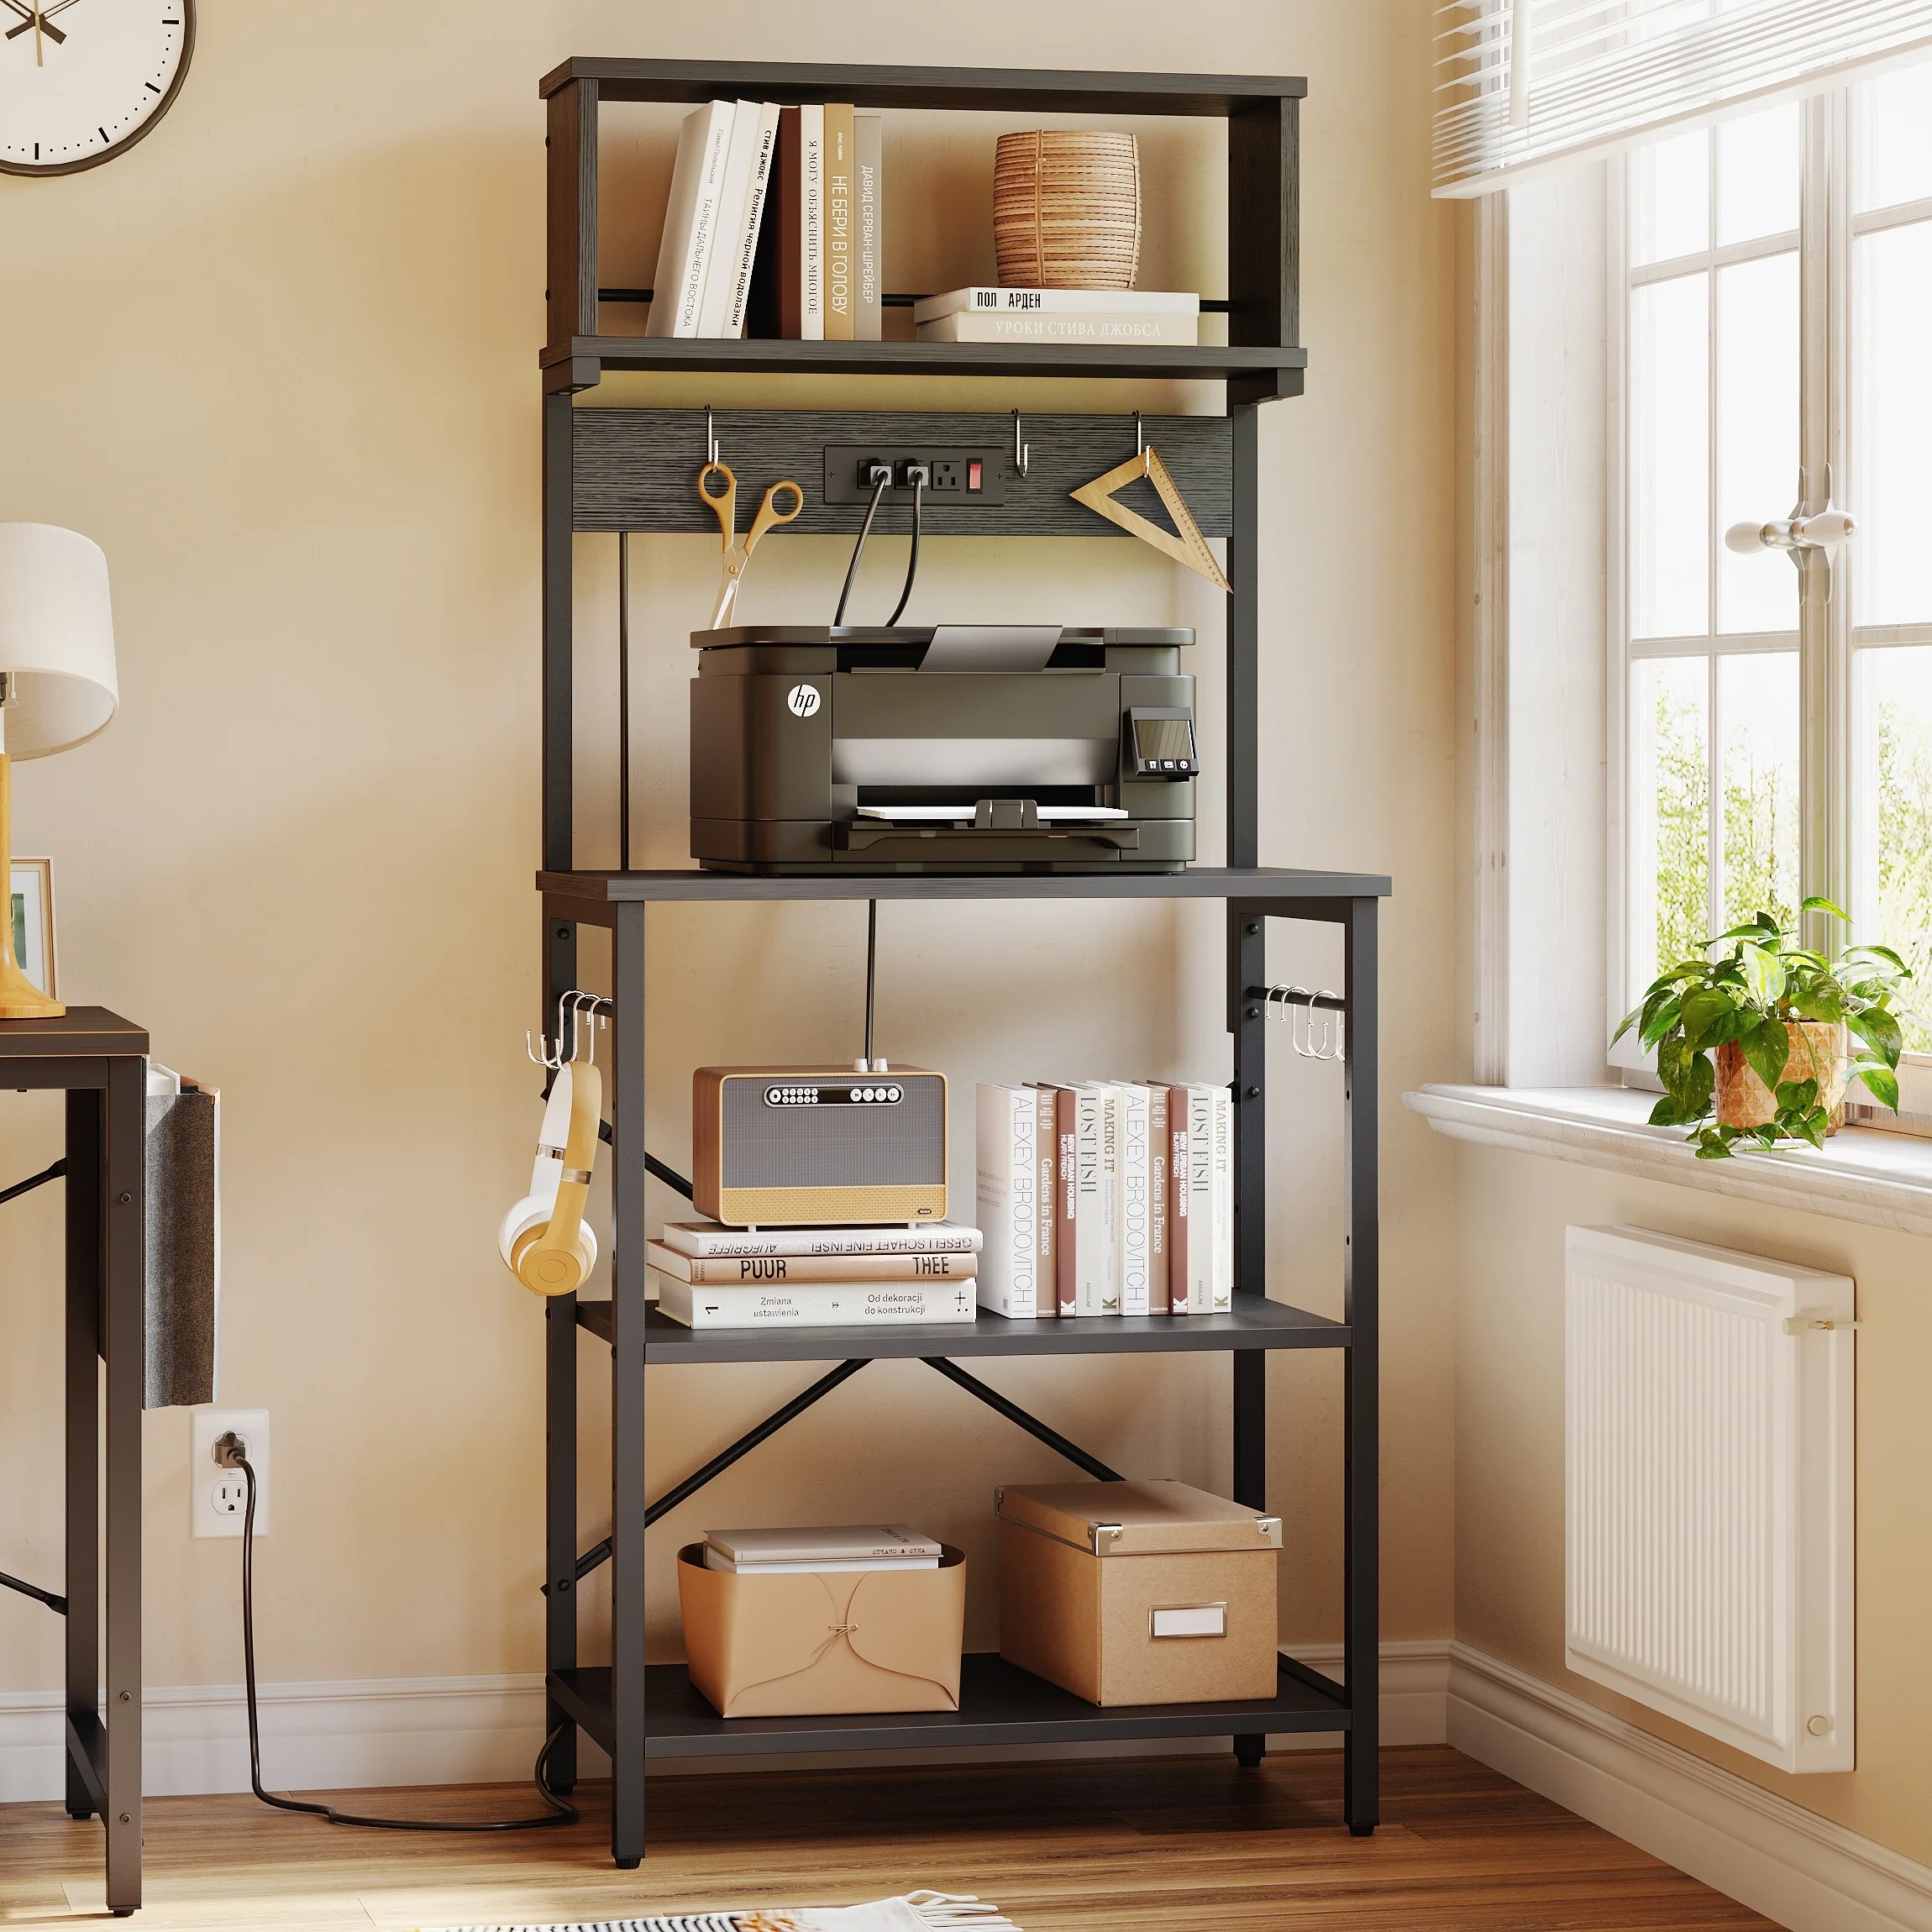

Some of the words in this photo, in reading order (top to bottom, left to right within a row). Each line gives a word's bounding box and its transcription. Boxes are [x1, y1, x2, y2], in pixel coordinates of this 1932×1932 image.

[808, 151, 817, 184] МОГУ
[832, 176, 848, 195] НЕ
[861, 165, 874, 203] ДАВИД
[748, 187, 764, 230] Религия
[808, 188, 817, 260] ОБЪЯСНИТЬ
[832, 198, 848, 237] БЕРИ
[690, 231, 707, 281] ДАЛЬНЕГО
[741, 232, 754, 270] черной
[832, 241, 848, 252] В
[862, 205, 876, 303] СЕРВАН-ШРЕЙБЕР
[731, 270, 748, 327] водолазки
[808, 265, 817, 315] МНОГОЕ
[832, 255, 848, 316] ГОЛОВУ
[976, 291, 997, 307] ПОЛ
[1008, 292, 1042, 310] АРДЕН
[683, 283, 698, 328] ВОСТОКА
[995, 321, 1044, 335] УРОКИ
[1047, 322, 1096, 336] СТИВА
[1100, 323, 1162, 338] ДЖОБСА
[792, 685, 816, 717] hp
[1013, 1096, 1032, 1171] ALEXEY
[1080, 1097, 1097, 1145] LOST
[1104, 1098, 1116, 1154] MAKING
[1126, 1095, 1145, 1169] ALEXEY
[1192, 1097, 1209, 1145] LOST
[1215, 1099, 1226, 1155] MAKING
[1067, 1134, 1075, 1153] NEW
[1041, 1158, 1053, 1203] Gardens
[1067, 1153, 1075, 1182] URBAN
[1080, 1152, 1097, 1193] FISH
[1104, 1158, 1116, 1173] IT
[1153, 1156, 1165, 1201] Gardens
[1192, 1152, 1209, 1192] FISH
[1215, 1158, 1226, 1173] IT
[1041, 1205, 1053, 1216] in
[1067, 1182, 1075, 1220] HOUSING
[1153, 1203, 1165, 1214] in
[1179, 1180, 1188, 1216] HOUSING
[1013, 1178, 1033, 1303] BRODOVITCH
[1041, 1218, 1053, 1256] France
[1126, 1176, 1146, 1300] BRODOVITCH
[1153, 1215, 1165, 1253] France
[740, 1259, 786, 1279] PUUR
[912, 1257, 949, 1275] THEE
[753, 1309, 799, 1317] ustawienia
[760, 1297, 792, 1305] Zmiana
[864, 1305, 875, 1315] do
[877, 1305, 926, 1315] konstrukcji
[868, 1294, 880, 1303] Od
[882, 1293, 922, 1304] dekoracji
